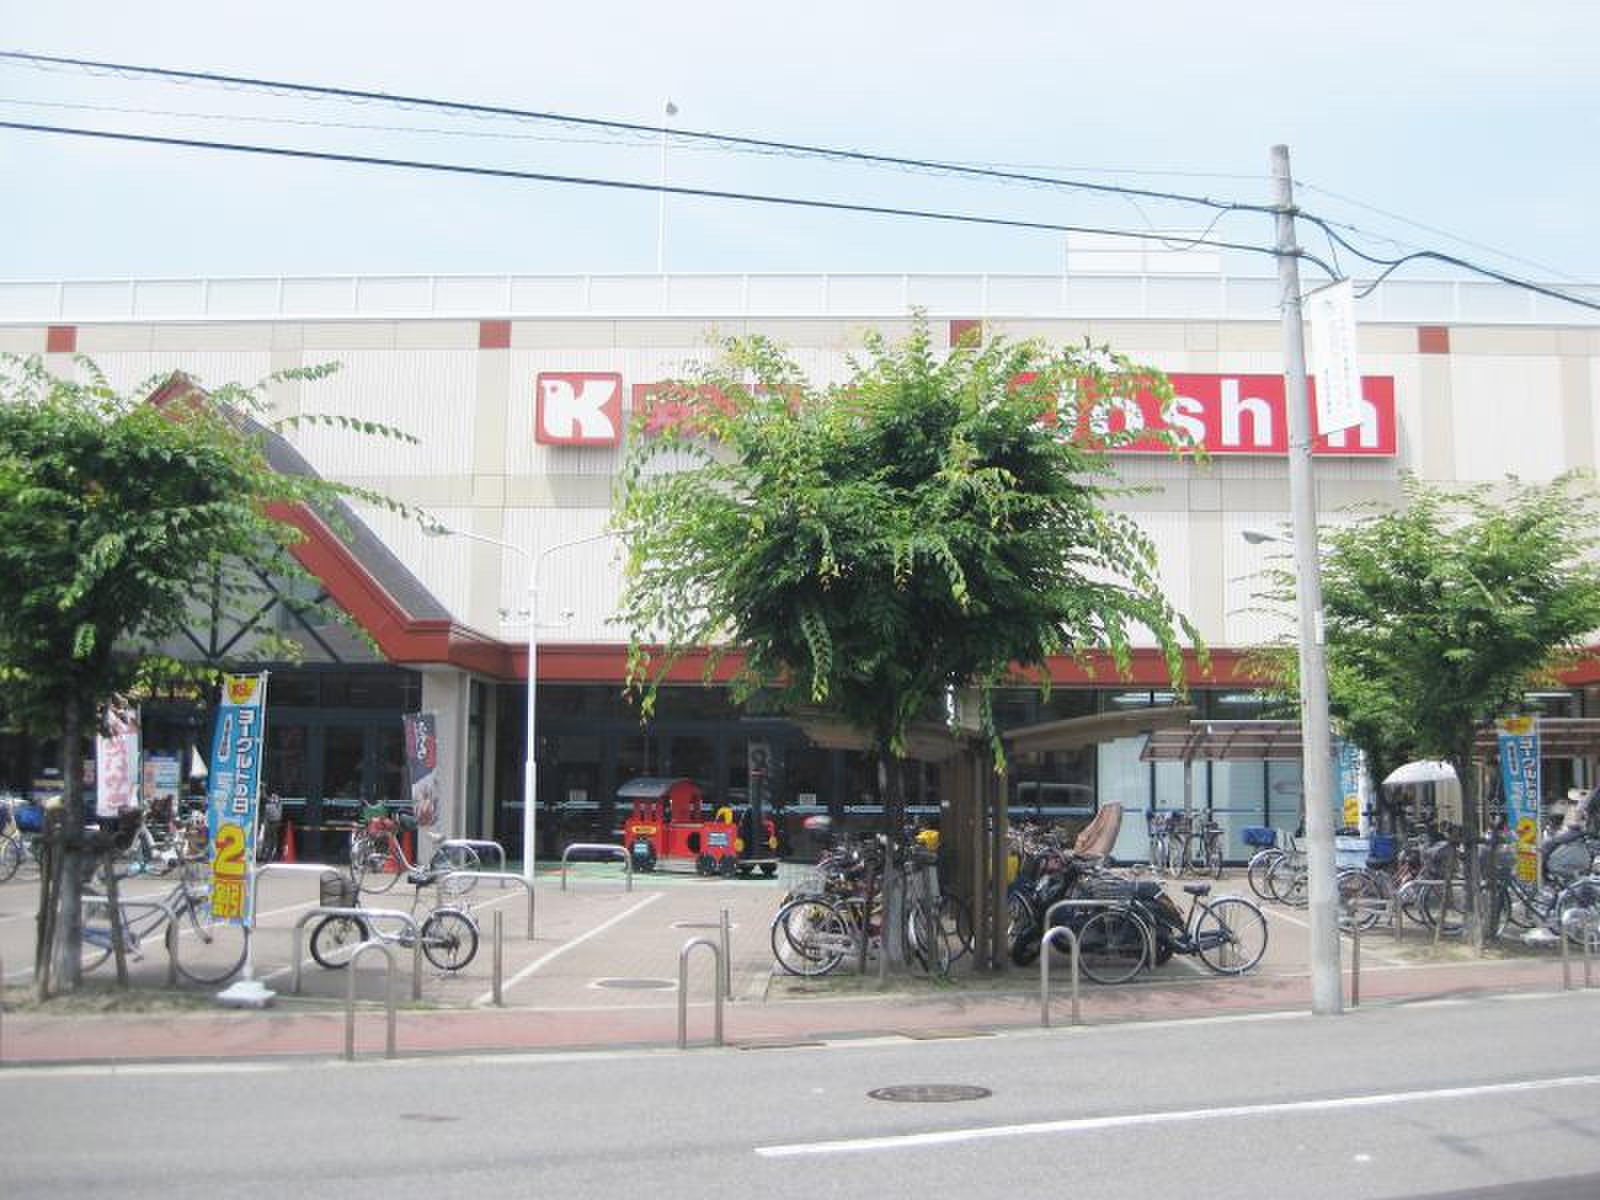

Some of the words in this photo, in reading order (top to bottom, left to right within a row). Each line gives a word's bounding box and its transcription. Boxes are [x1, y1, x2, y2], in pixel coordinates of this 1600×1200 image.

[1028, 378, 1379, 447] Joshn
[232, 708, 256, 814] ヨーグルトの日
